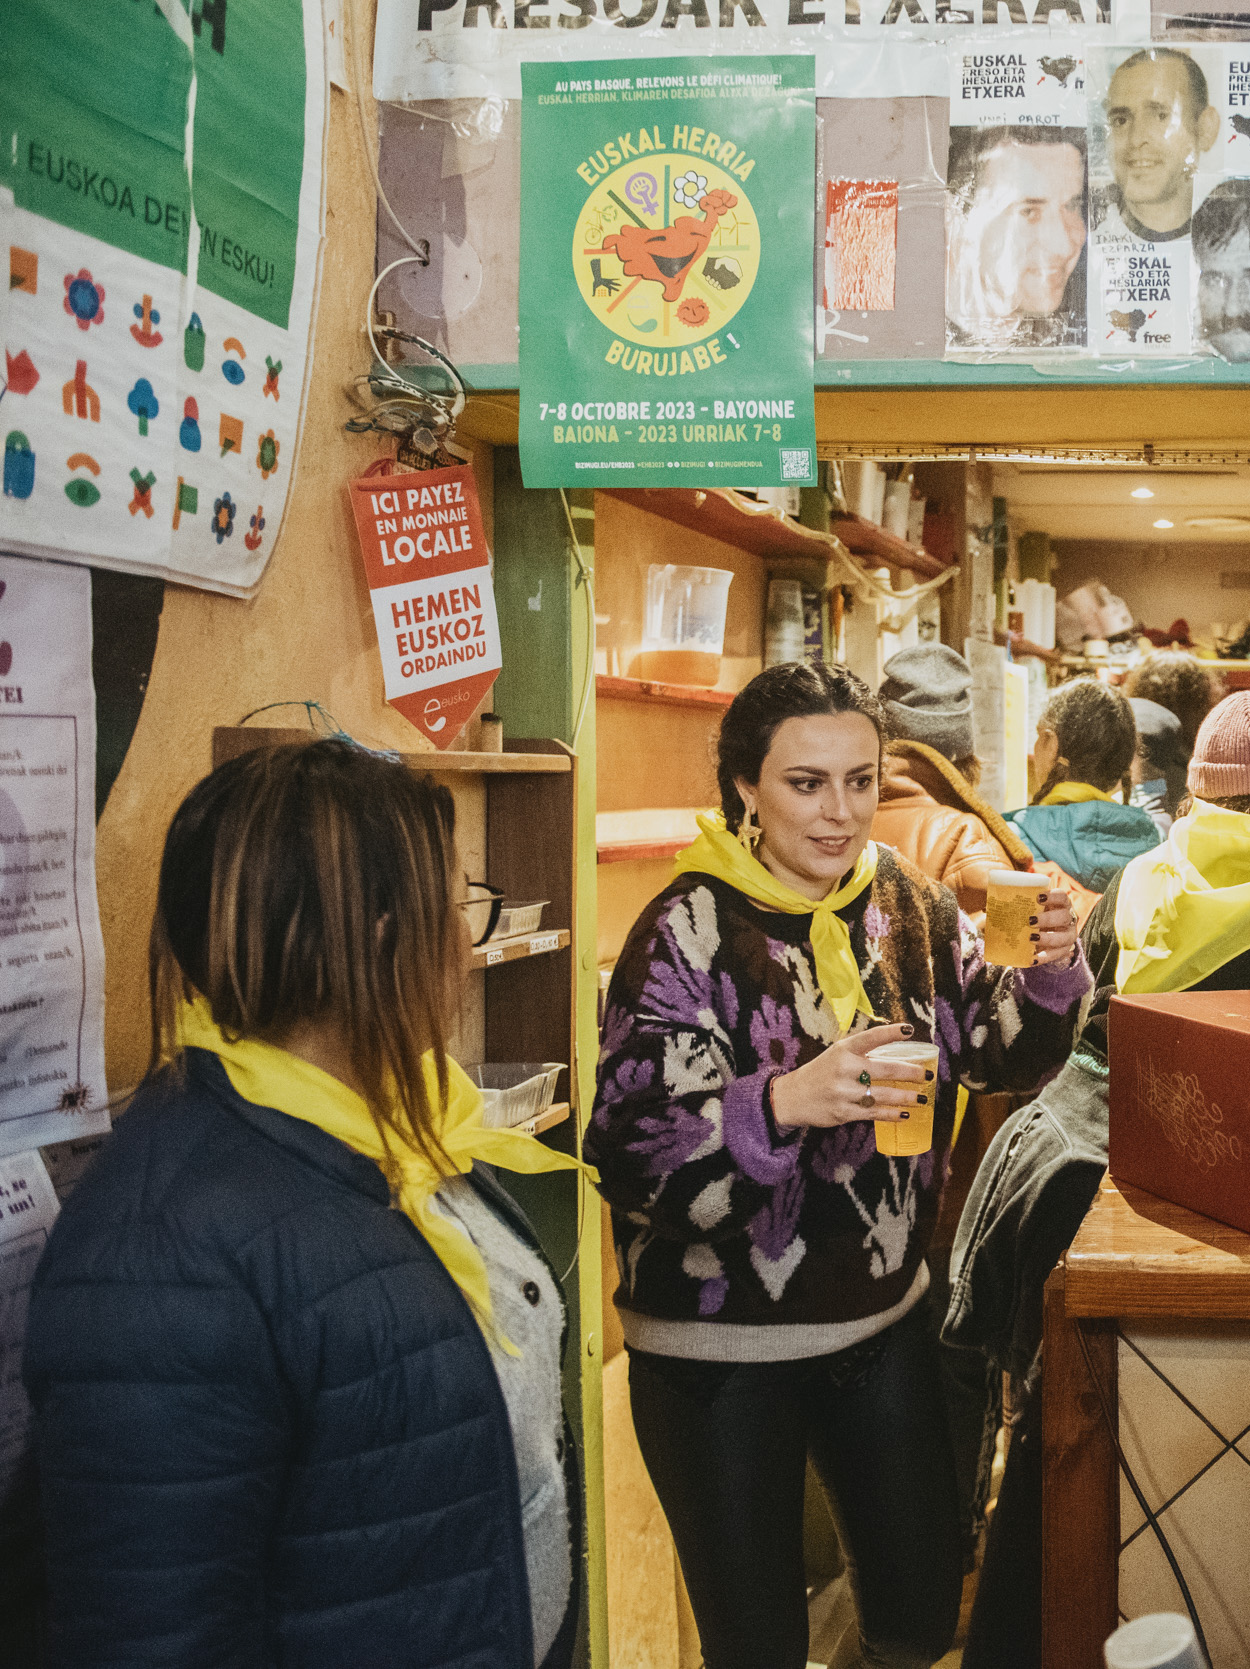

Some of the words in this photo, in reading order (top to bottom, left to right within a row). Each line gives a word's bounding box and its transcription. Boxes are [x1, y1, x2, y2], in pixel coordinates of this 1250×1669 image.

[963, 54, 1027, 68] EUSKAL
[962, 75, 1026, 85] IHESLARIAK
[1003, 67, 1025, 76] ETA
[555, 81, 569, 92] AU
[569, 80, 592, 92] PAYS
[594, 78, 634, 91] BASQUE,
[636, 77, 684, 89] RELEVONS
[686, 75, 698, 87] LE
[700, 72, 722, 86] DÉFI
[723, 74, 782, 85] CLIMATIQUE!
[537, 93, 572, 105] EUSKAL
[621, 89, 668, 101] KLIMAREN
[670, 88, 717, 100] DESAFIOA
[962, 85, 1026, 99] ETXERA
[1018, 114, 1060, 126] PAROT
[576, 125, 667, 187] EUSKAL
[672, 124, 757, 183] HERRIA
[27, 141, 136, 218] EUSKOA
[144, 196, 218, 258] DEN
[221, 236, 275, 289] ESKU!
[1106, 257, 1171, 270] SKAL
[1109, 279, 1170, 287] HESLARIAK
[1148, 270, 1170, 278] ETA
[1106, 288, 1171, 302] TXERA
[1143, 331, 1171, 344] free
[604, 338, 728, 377] BURUJABE
[539, 403, 567, 421] 7-8
[572, 402, 651, 420] OCTOBRE
[656, 402, 695, 420] 2023
[714, 400, 795, 419] BAYONNE
[553, 425, 620, 444] BAIONA
[638, 425, 678, 443] 2023
[683, 424, 748, 442] URRIAK
[753, 424, 782, 442] 7-8
[371, 492, 401, 515] ICI
[407, 481, 465, 511] PAYEZ
[376, 518, 399, 536] EN
[402, 506, 468, 531] MONNAIE
[380, 525, 473, 567] LOCALE
[391, 584, 482, 629] HEMEN
[396, 613, 486, 657] EUSKOZ
[400, 641, 487, 679] ORDAINDU
[441, 689, 471, 708] eusko
